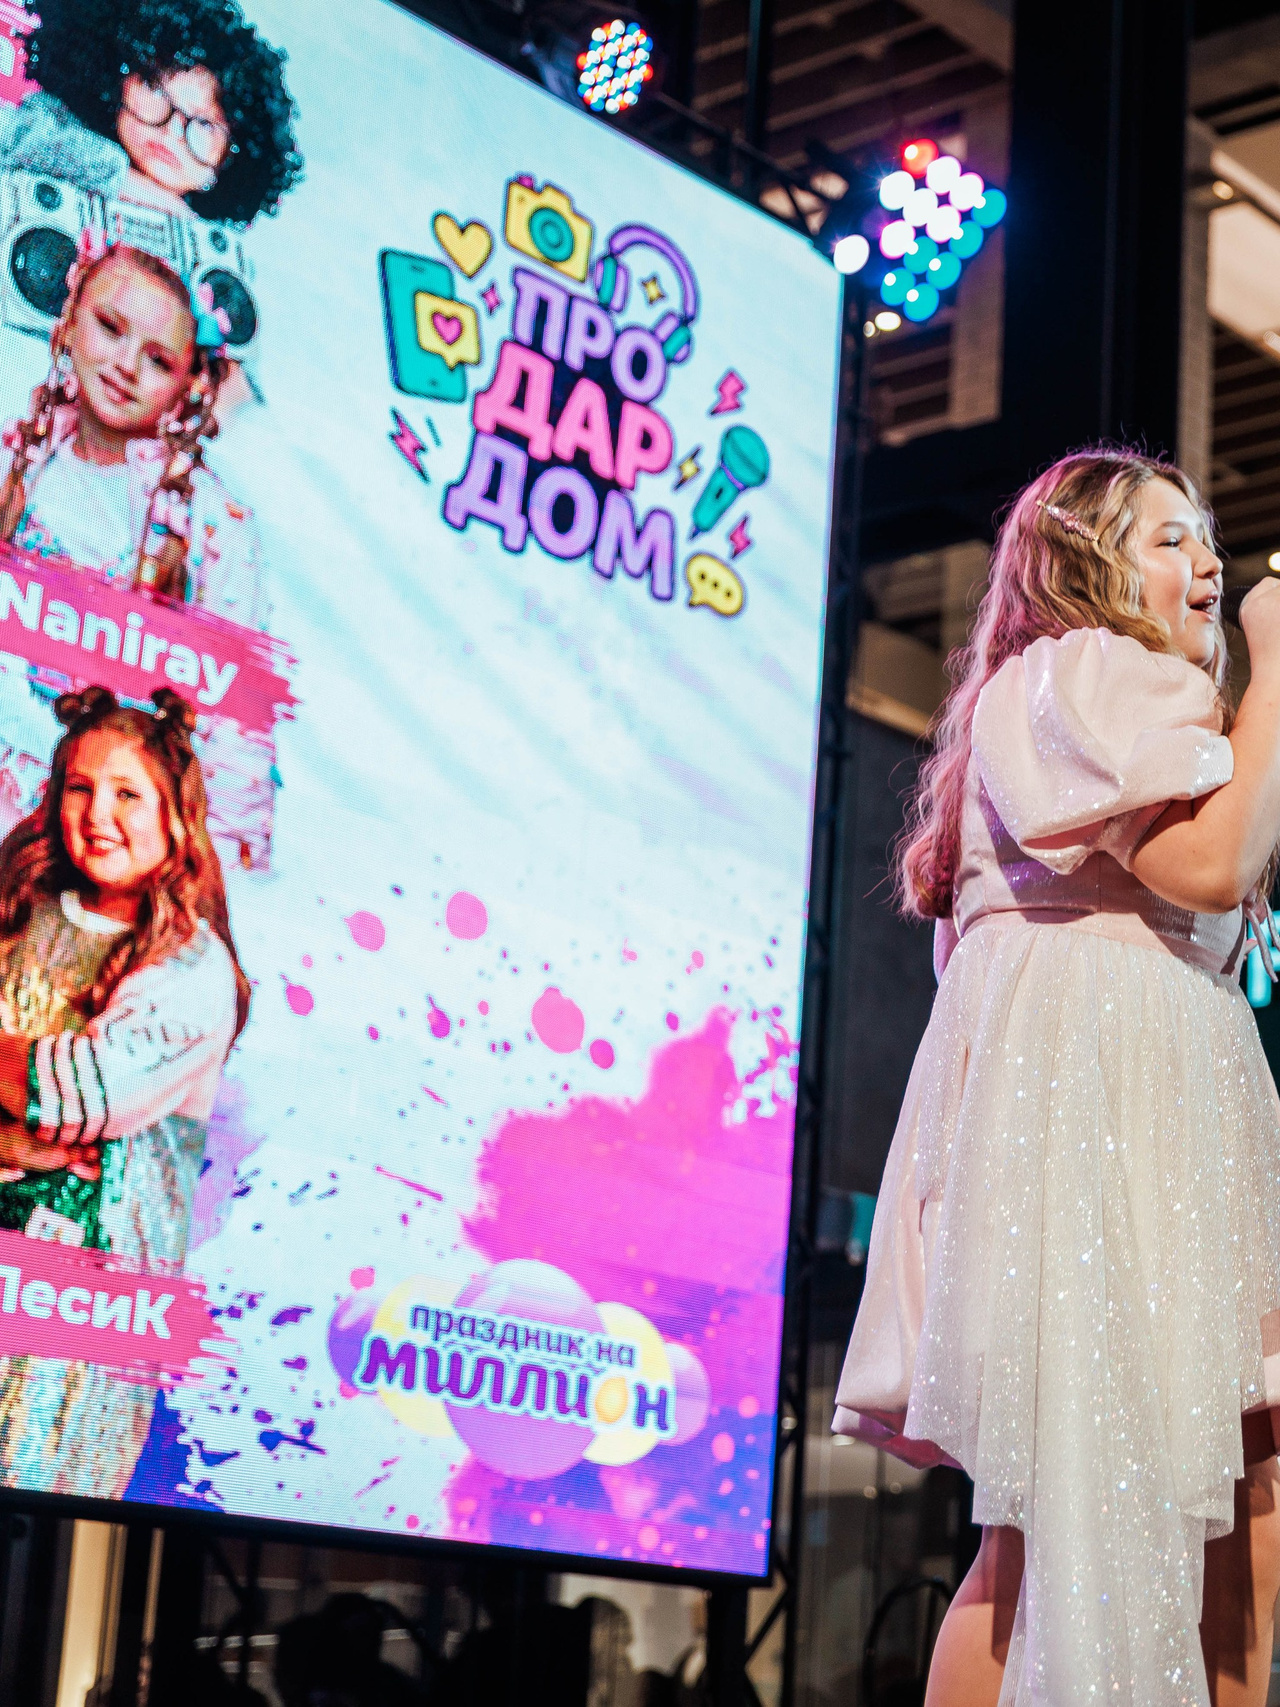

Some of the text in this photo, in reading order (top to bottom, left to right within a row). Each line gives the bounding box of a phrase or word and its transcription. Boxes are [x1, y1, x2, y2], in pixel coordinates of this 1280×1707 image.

[513, 266, 669, 402] ПРО
[472, 339, 674, 490] ДАР
[443, 432, 676, 602] ДОМ
[0, 570, 239, 706] Naniray
[410, 1305, 635, 1368] праздник на
